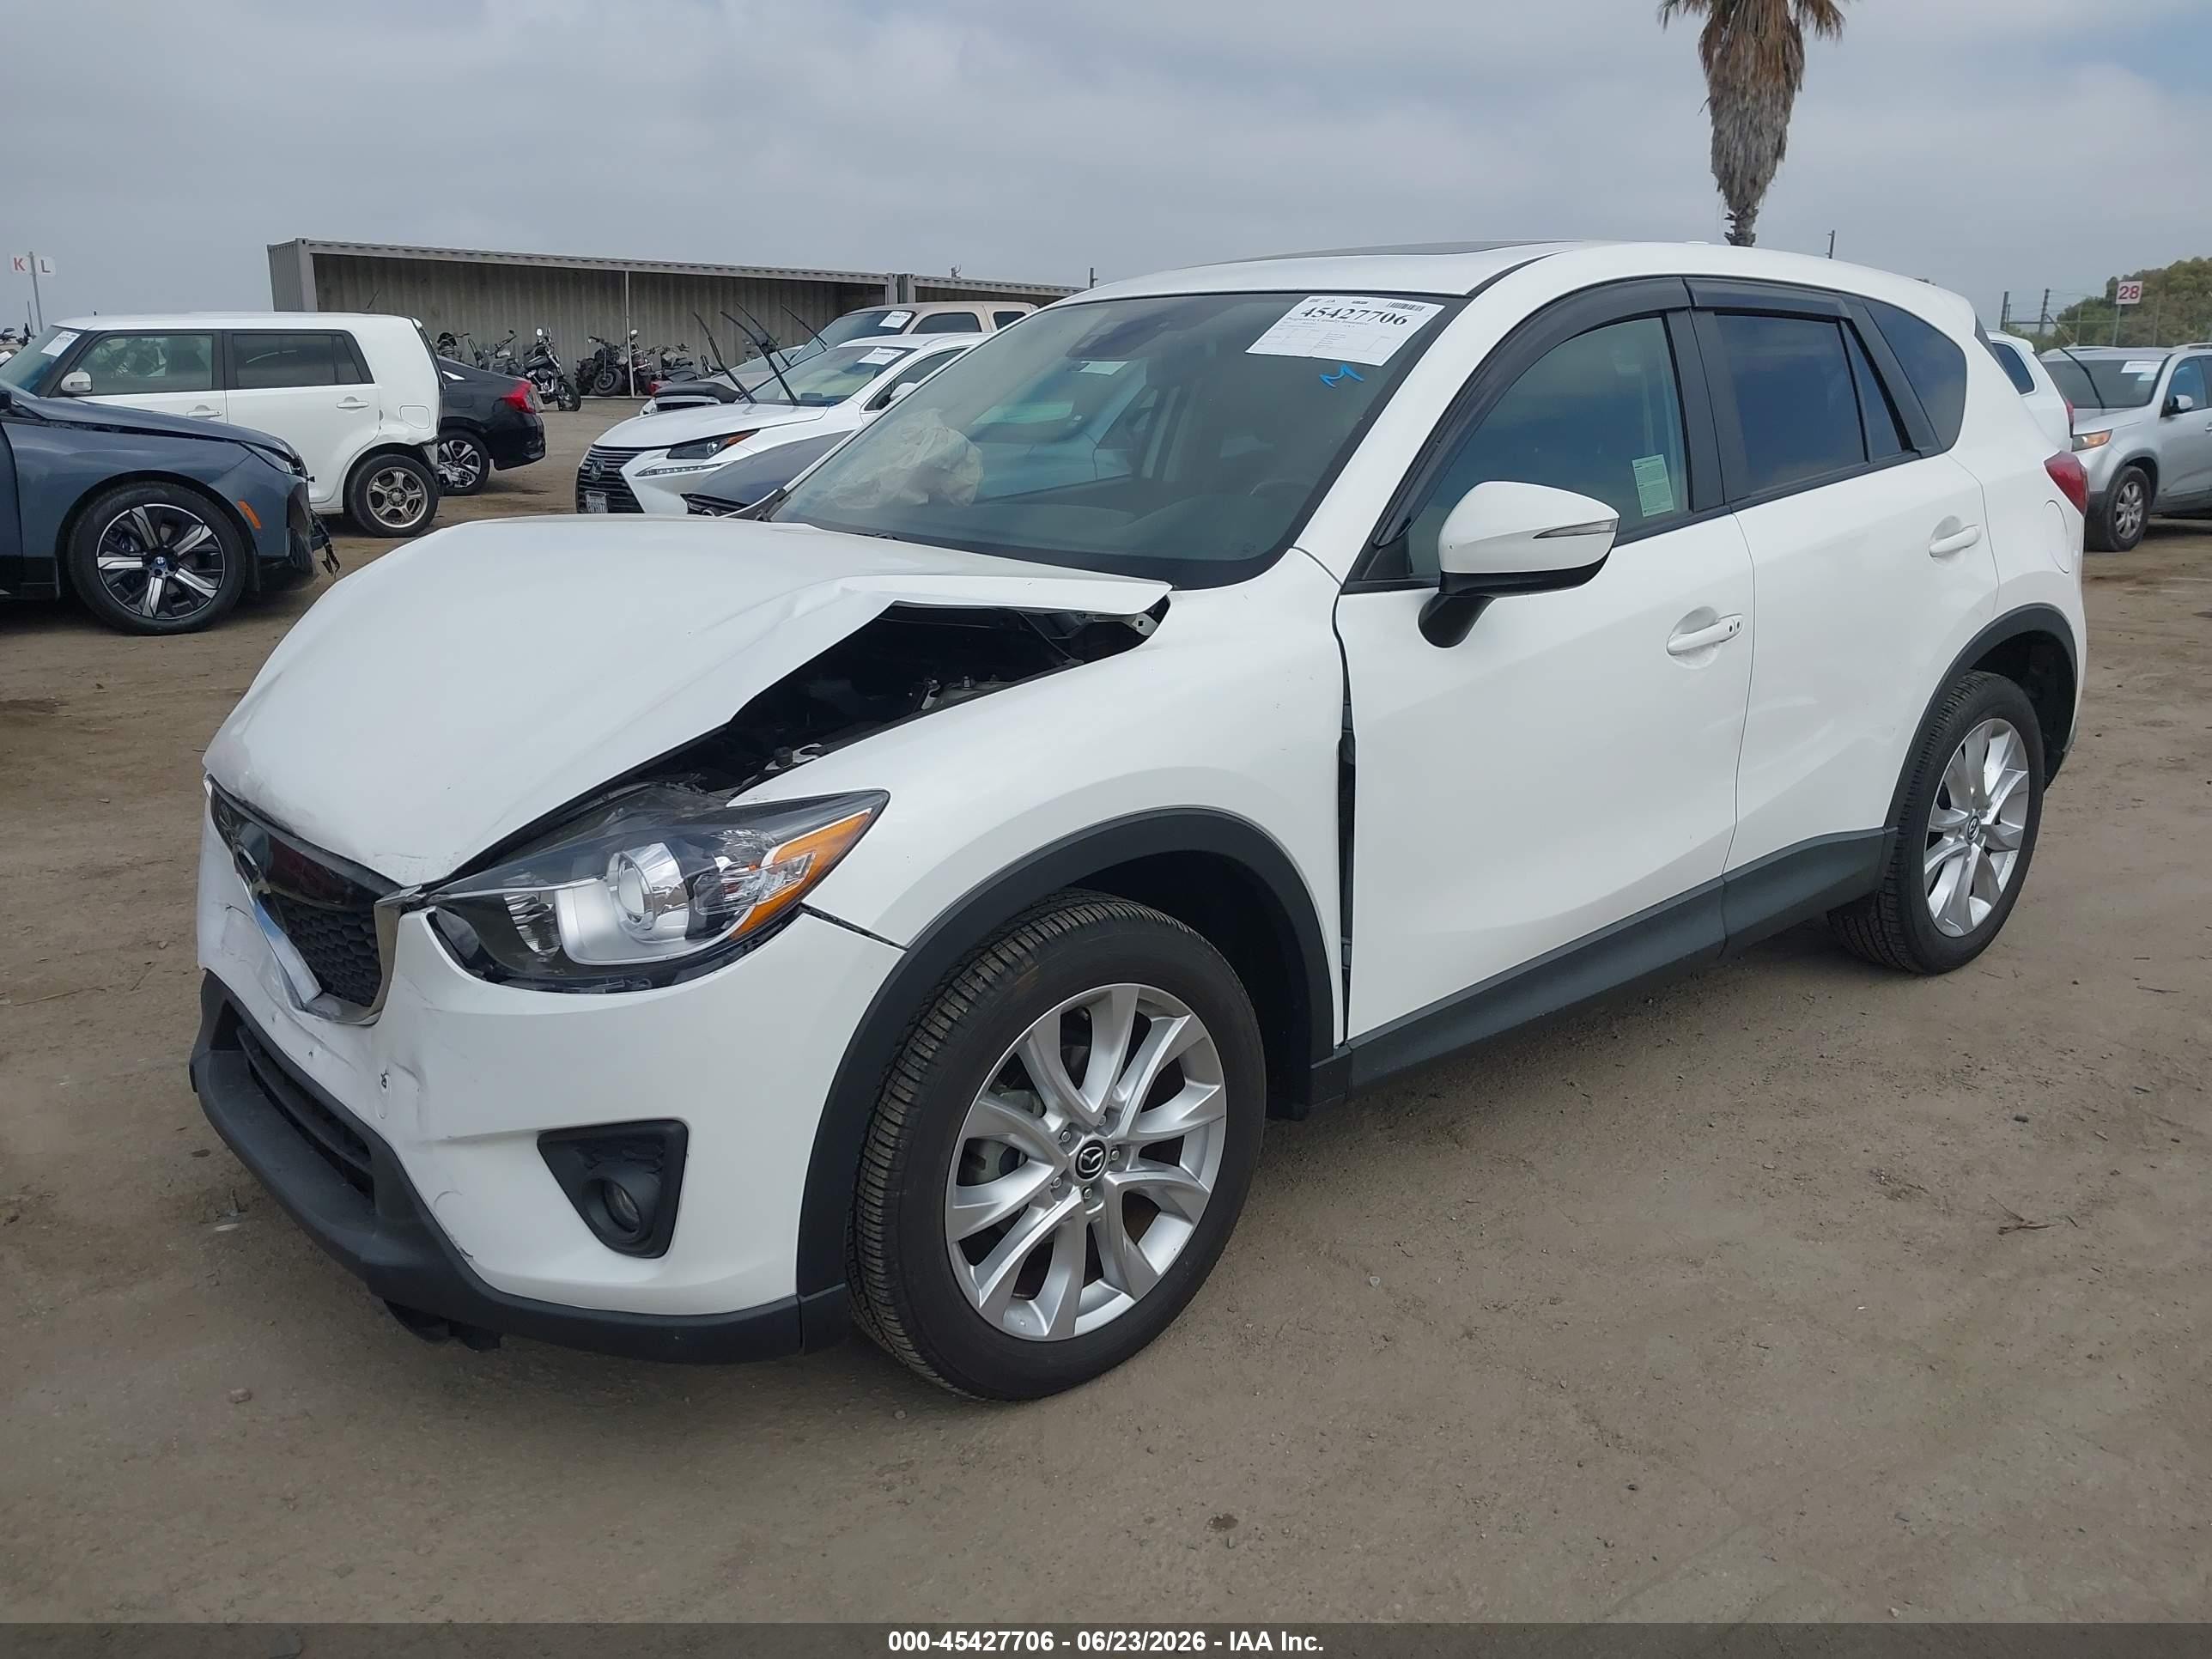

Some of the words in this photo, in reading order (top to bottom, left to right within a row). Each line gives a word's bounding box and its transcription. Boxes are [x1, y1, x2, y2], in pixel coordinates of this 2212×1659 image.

[13, 257, 26, 271] K
[40, 259, 52, 273] L
[2118, 285, 2140, 300] 28
[1299, 307, 1413, 325] 45427706
